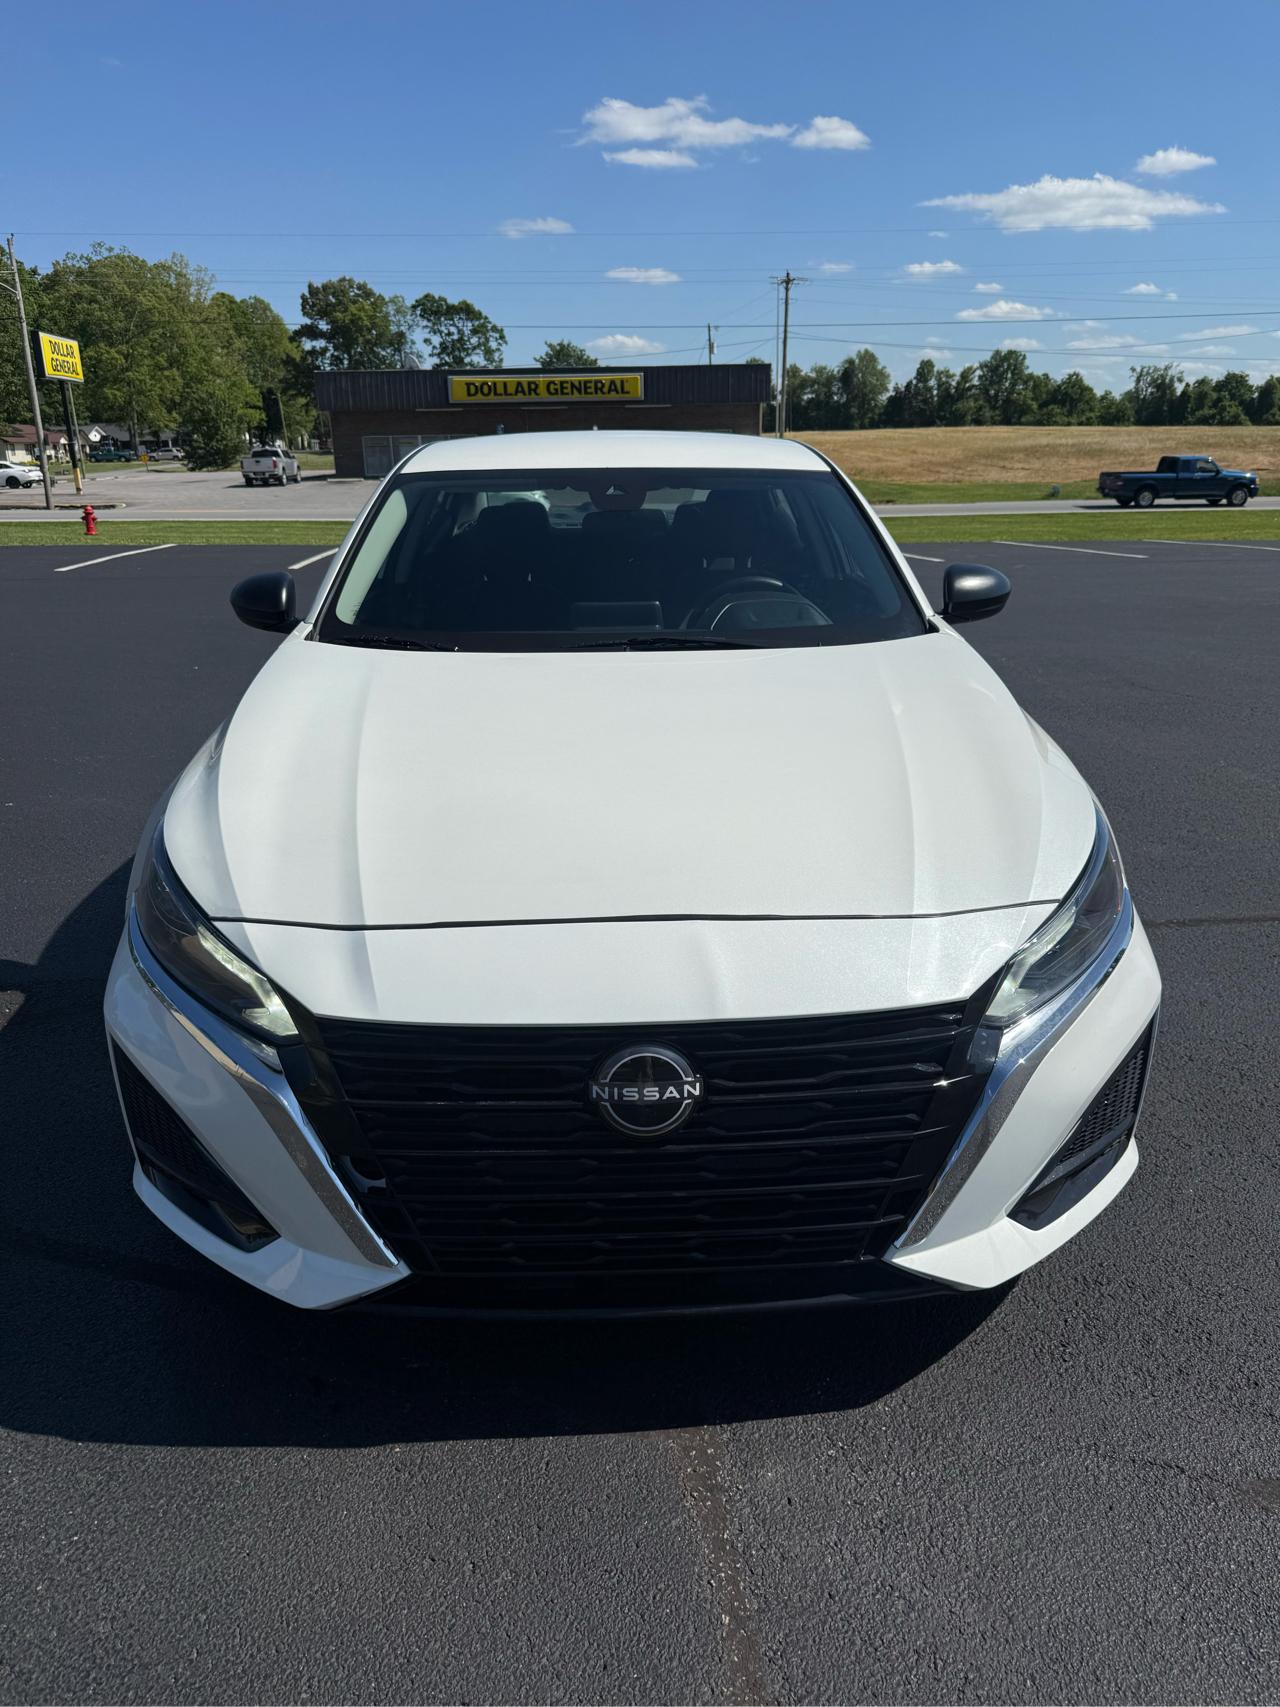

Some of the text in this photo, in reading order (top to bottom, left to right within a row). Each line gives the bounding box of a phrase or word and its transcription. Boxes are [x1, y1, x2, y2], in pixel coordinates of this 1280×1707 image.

[49, 340, 76, 359] DOLLAR
[50, 357, 80, 376] GENERAL
[465, 379, 631, 397] DOLLAR GENERAL
[592, 1082, 700, 1101] NISSAN
